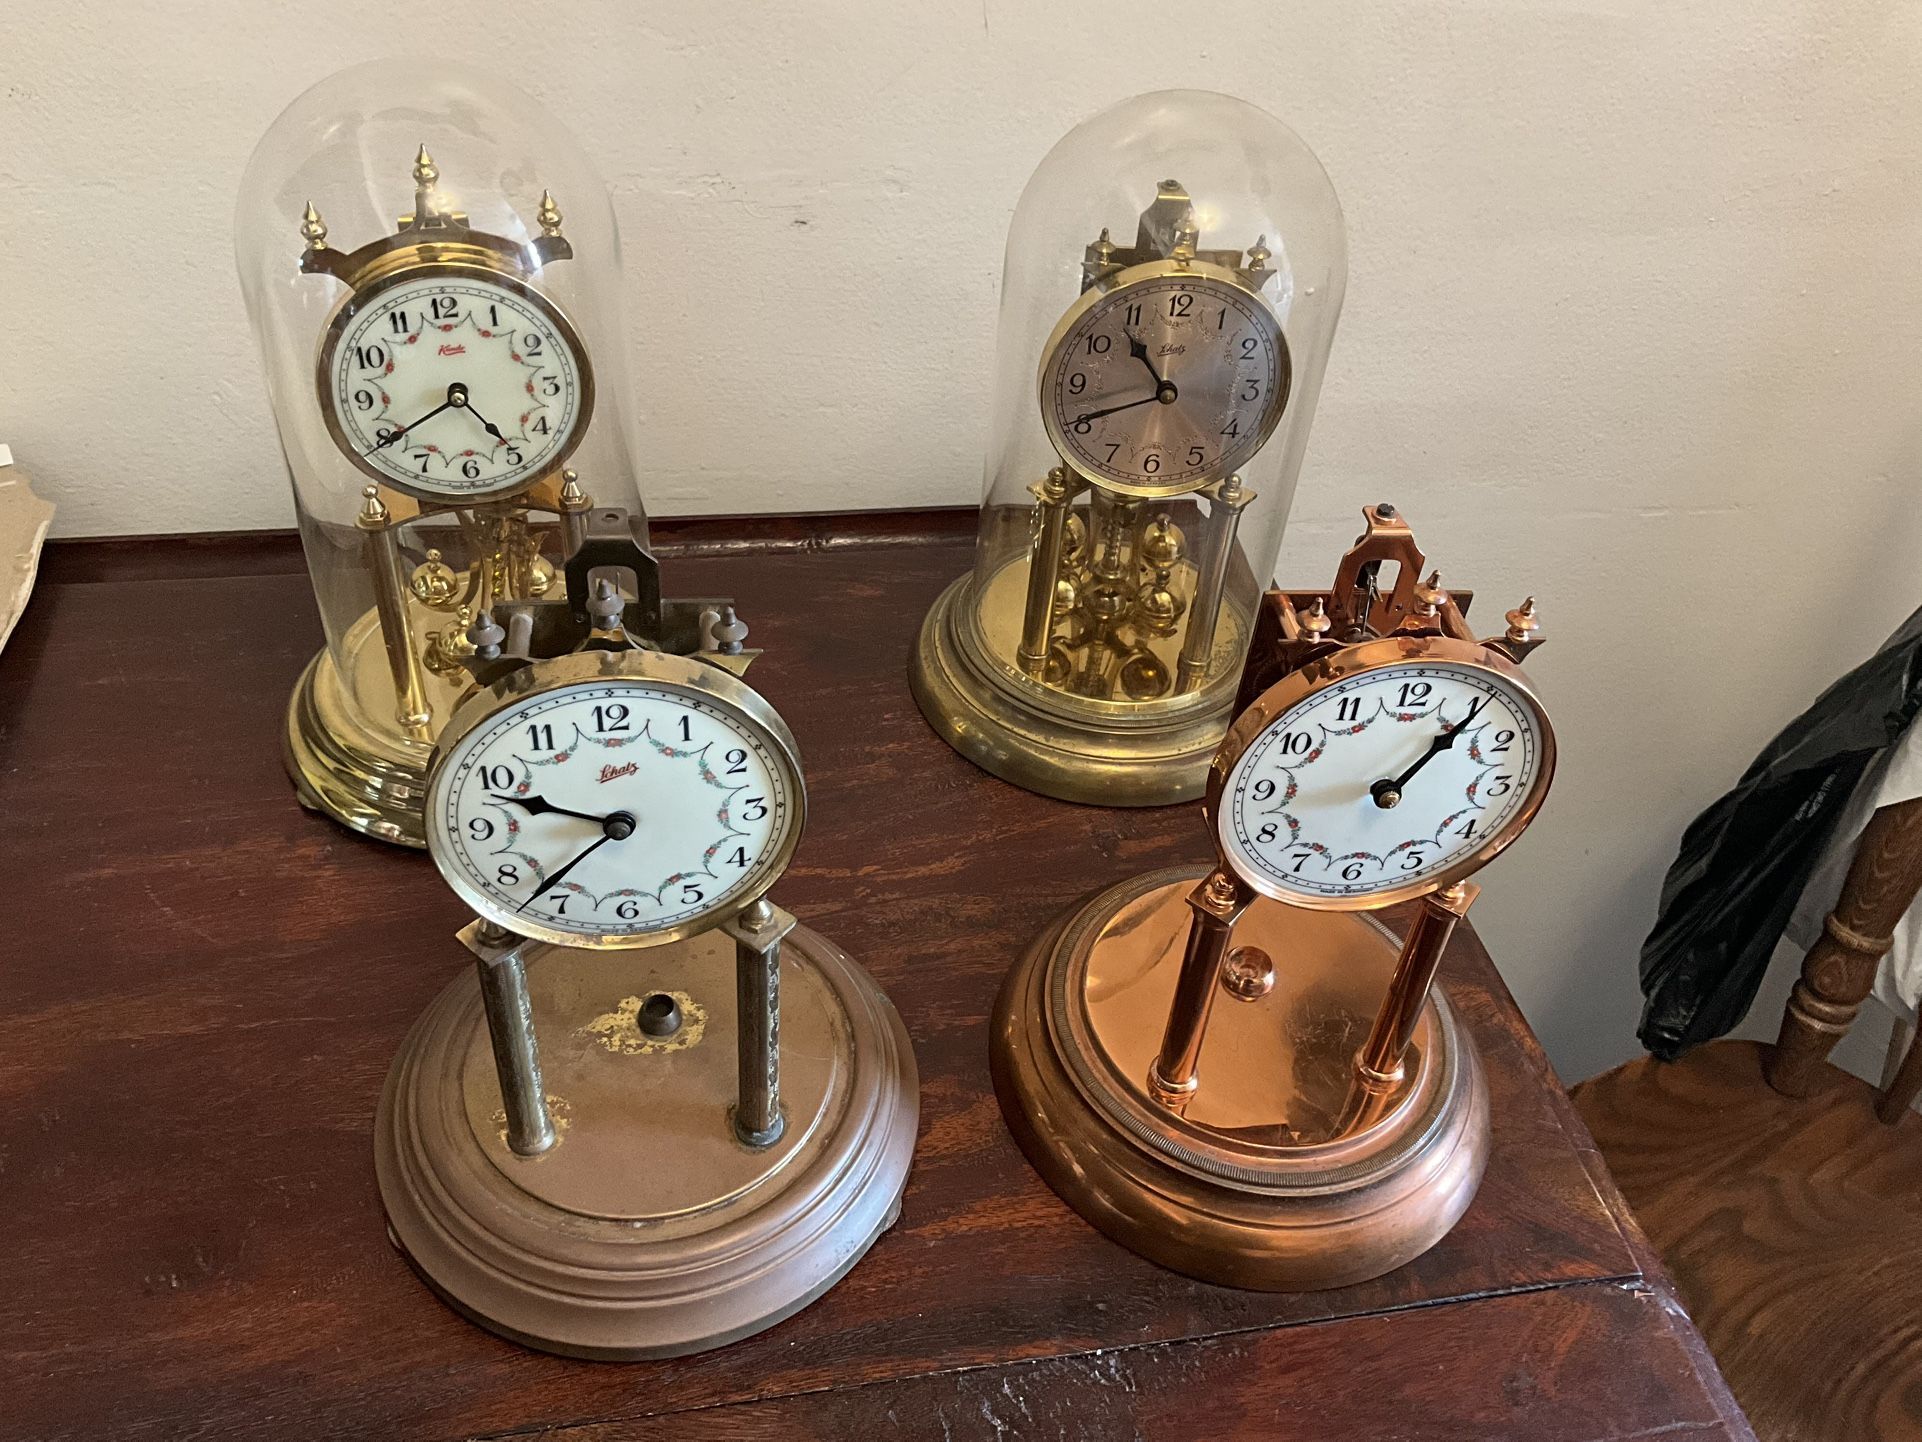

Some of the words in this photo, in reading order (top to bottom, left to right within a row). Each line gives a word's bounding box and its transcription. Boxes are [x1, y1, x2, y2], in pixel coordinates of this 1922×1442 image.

[430, 297, 459, 320] 12
[489, 305, 499, 327] 1
[1125, 304, 1141, 326] 11
[1168, 294, 1194, 317] 12
[389, 311, 409, 333] 11
[1217, 308, 1226, 329] 1
[524, 334, 543, 357] 2
[1086, 333, 1111, 355] 10
[1240, 338, 1258, 360] 2
[355, 345, 385, 370] 10
[543, 376, 560, 396] 3
[1069, 373, 1087, 395] 9
[1241, 379, 1259, 401] 3
[354, 390, 374, 411] 9
[532, 416, 551, 435] 4
[1074, 414, 1092, 434] 8
[1220, 418, 1239, 438] 4
[376, 428, 394, 448] 8
[414, 454, 431, 473] 7
[506, 447, 523, 466] 5
[1105, 444, 1120, 463] 7
[1143, 454, 1160, 473] 6
[1186, 447, 1204, 466] 5
[462, 460, 480, 479] 6
[1396, 682, 1432, 707] 12
[591, 703, 630, 733] 12
[1336, 697, 1361, 721] 11
[527, 724, 555, 751] 11
[678, 715, 693, 741] 1
[1279, 732, 1312, 755] 10
[1490, 730, 1514, 752] 2
[725, 749, 748, 774] 2
[476, 765, 514, 790] 10
[1487, 775, 1513, 796] 3
[1252, 779, 1276, 801] 9
[742, 797, 767, 820] 3
[468, 818, 494, 841] 9
[1256, 823, 1278, 843] 8
[1454, 819, 1477, 839] 4
[726, 846, 751, 868] 4
[1291, 854, 1311, 872] 7
[1401, 851, 1423, 870] 5
[496, 864, 520, 885] 8
[1341, 862, 1363, 880] 6
[549, 895, 570, 914] 7
[681, 884, 704, 904] 5
[616, 901, 639, 918] 6
